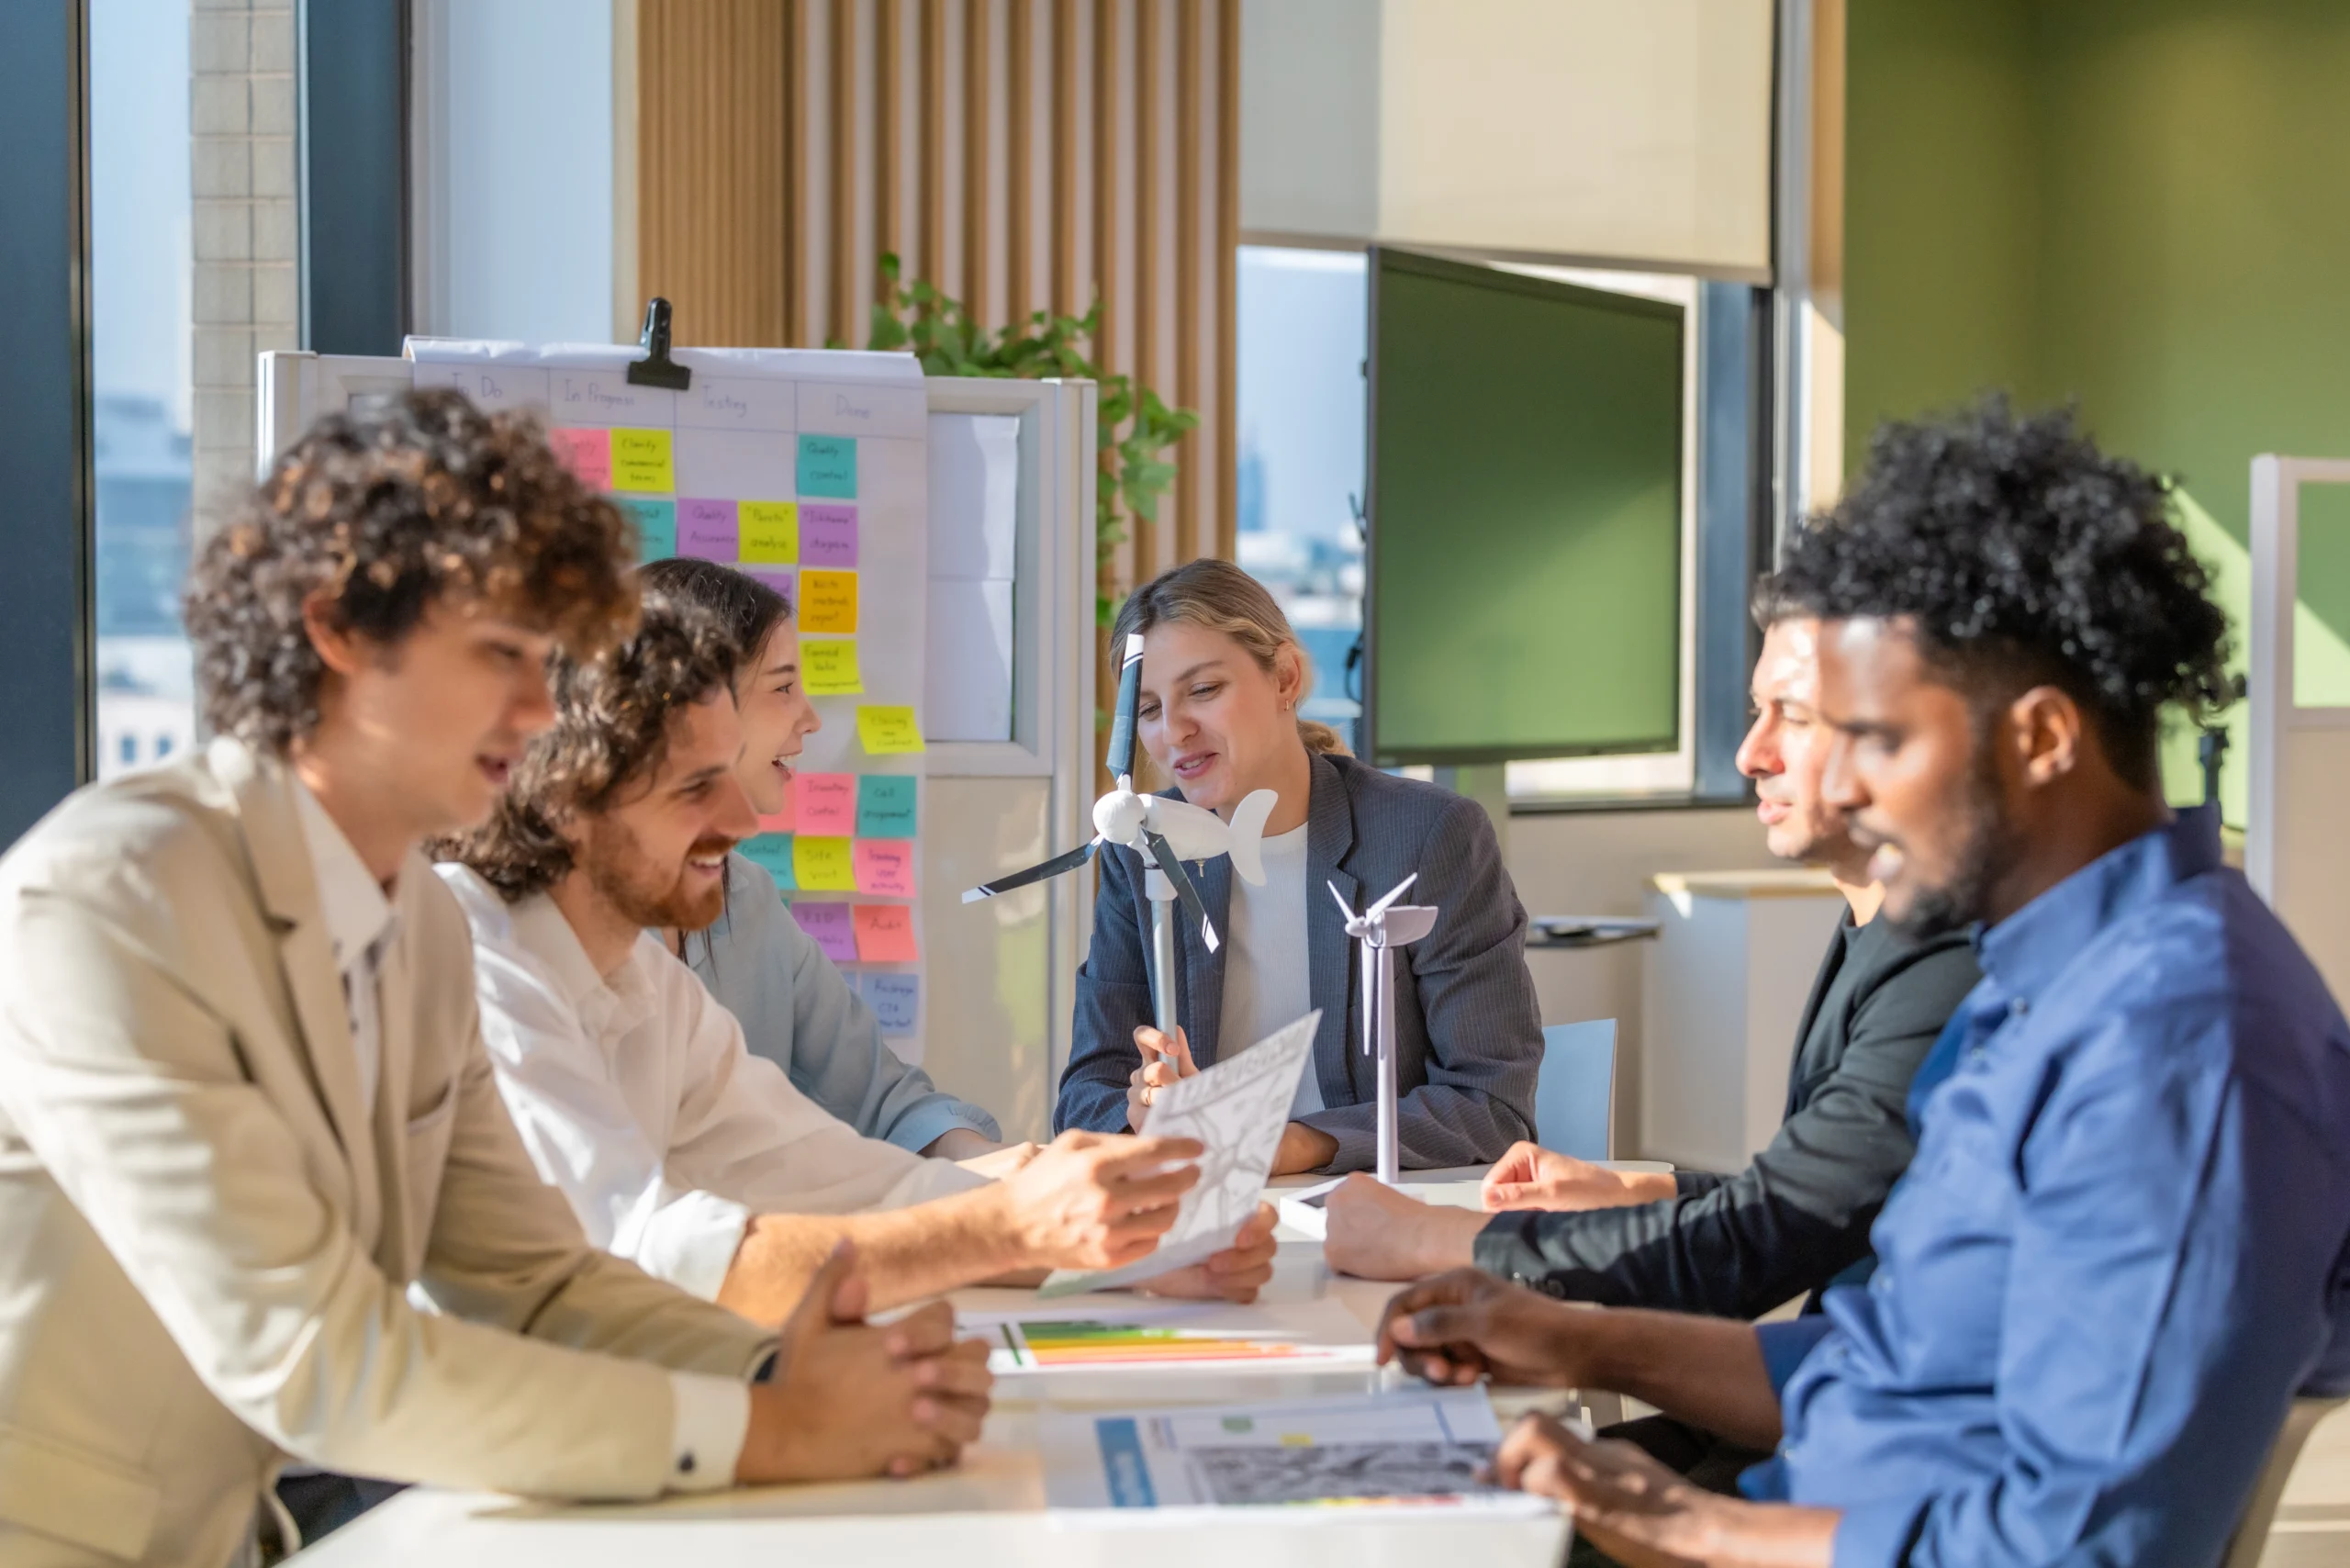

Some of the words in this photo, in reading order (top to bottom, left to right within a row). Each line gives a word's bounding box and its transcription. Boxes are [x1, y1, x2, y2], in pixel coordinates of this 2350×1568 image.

[481, 375, 503, 398] Do
[563, 378, 581, 403] In
[588, 382, 636, 409] Progress
[701, 385, 747, 419] Testing
[834, 393, 870, 420] Done
[806, 441, 840, 459] Quality
